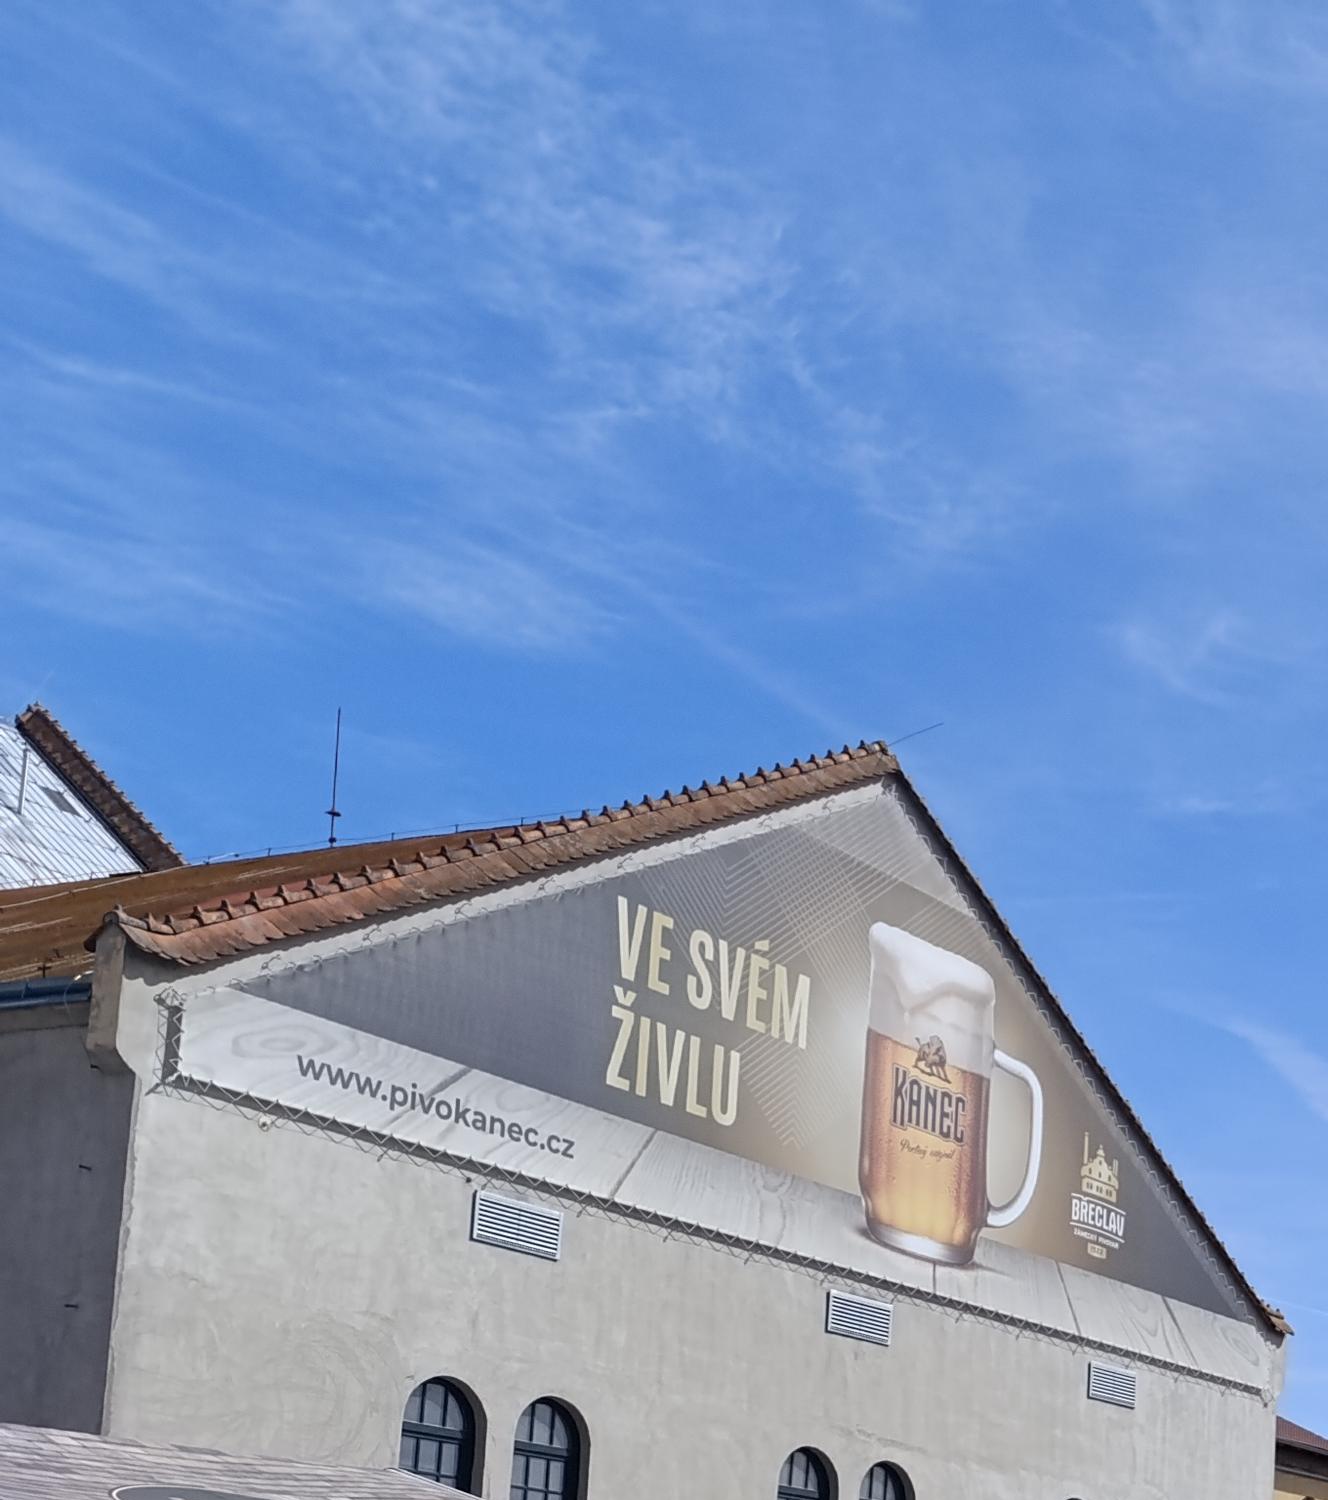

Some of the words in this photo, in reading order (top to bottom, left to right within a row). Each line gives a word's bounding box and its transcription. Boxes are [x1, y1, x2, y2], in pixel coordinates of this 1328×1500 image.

[617, 895, 674, 996] VE
[686, 929, 811, 1050] SVÉM
[296, 1053, 576, 1160] www.pivokanec.cz
[605, 984, 741, 1127] ŽIVLU
[891, 1065, 967, 1145] KANEC
